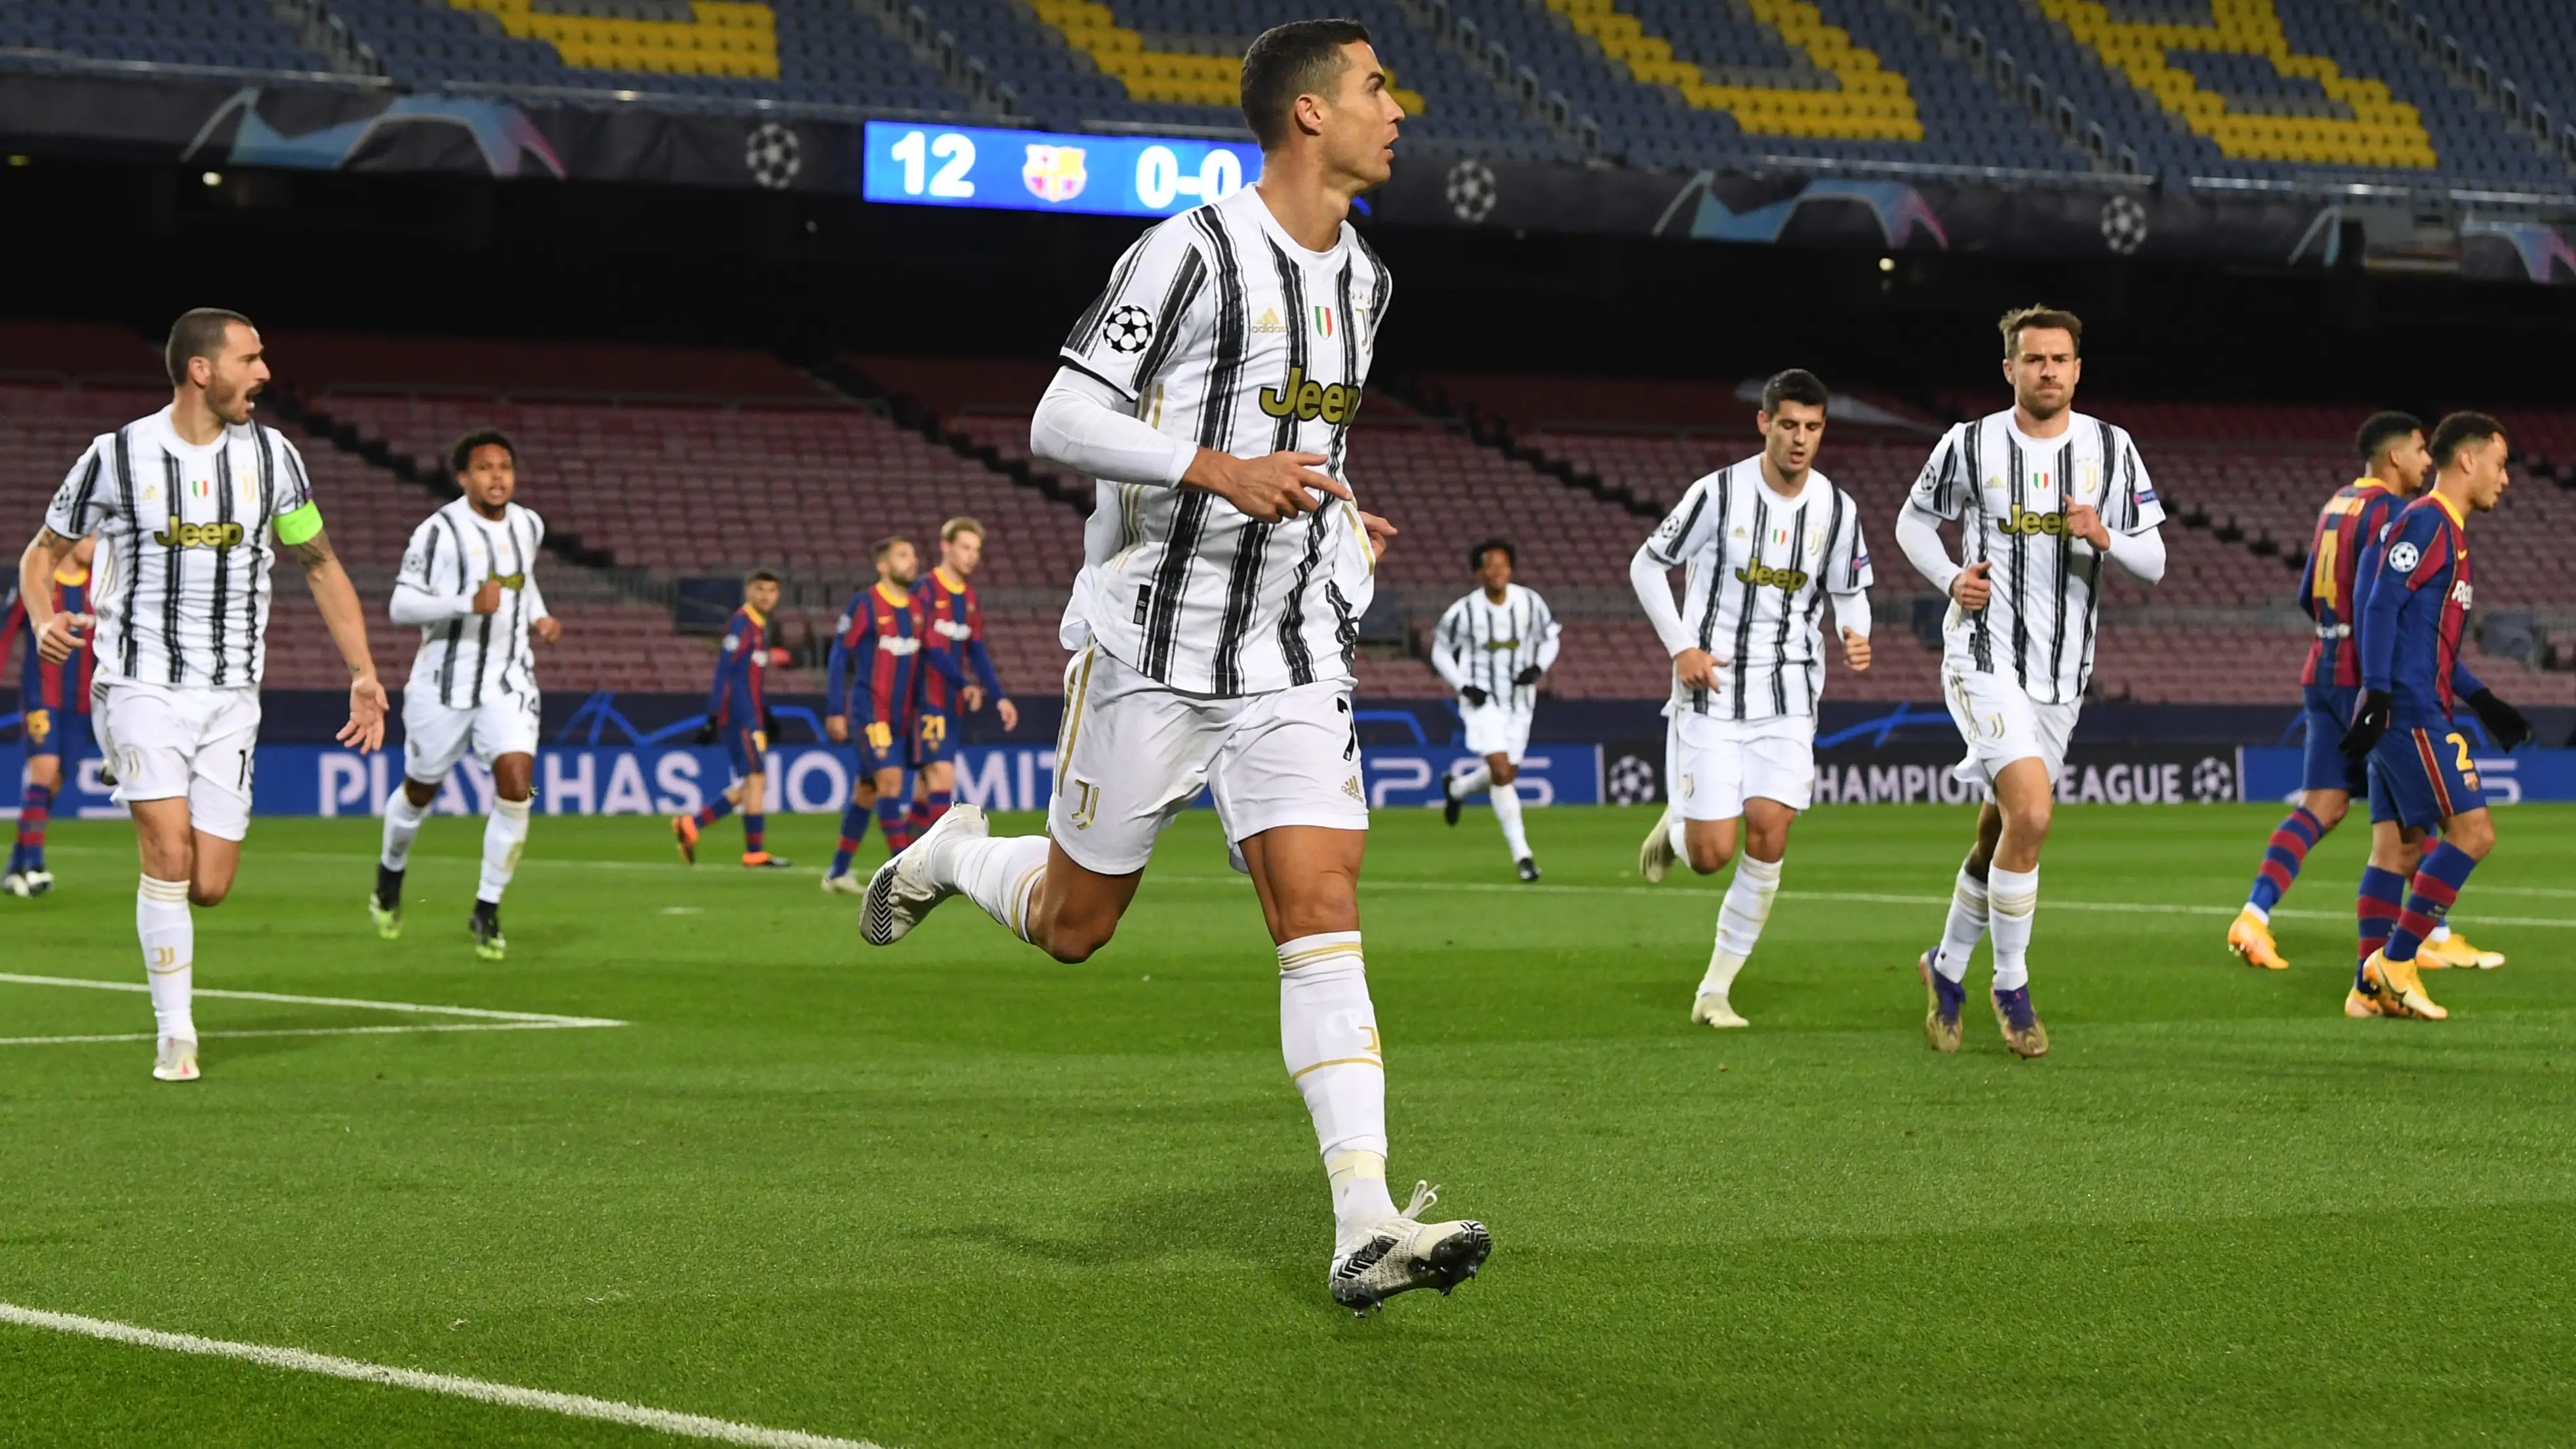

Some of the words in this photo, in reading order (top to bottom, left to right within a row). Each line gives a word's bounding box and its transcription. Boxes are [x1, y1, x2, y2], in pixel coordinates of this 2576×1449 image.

[891, 130, 976, 197] 12
[1135, 145, 1242, 208] 0-0
[1258, 365, 1363, 432] Jeep
[153, 515, 244, 551] Jeep
[1735, 557, 1809, 595] Jeep
[1336, 696, 1356, 763] 7
[2444, 732, 2474, 772] 2
[545, 751, 703, 816] HAS
[2052, 763, 2185, 805] EAGUE
